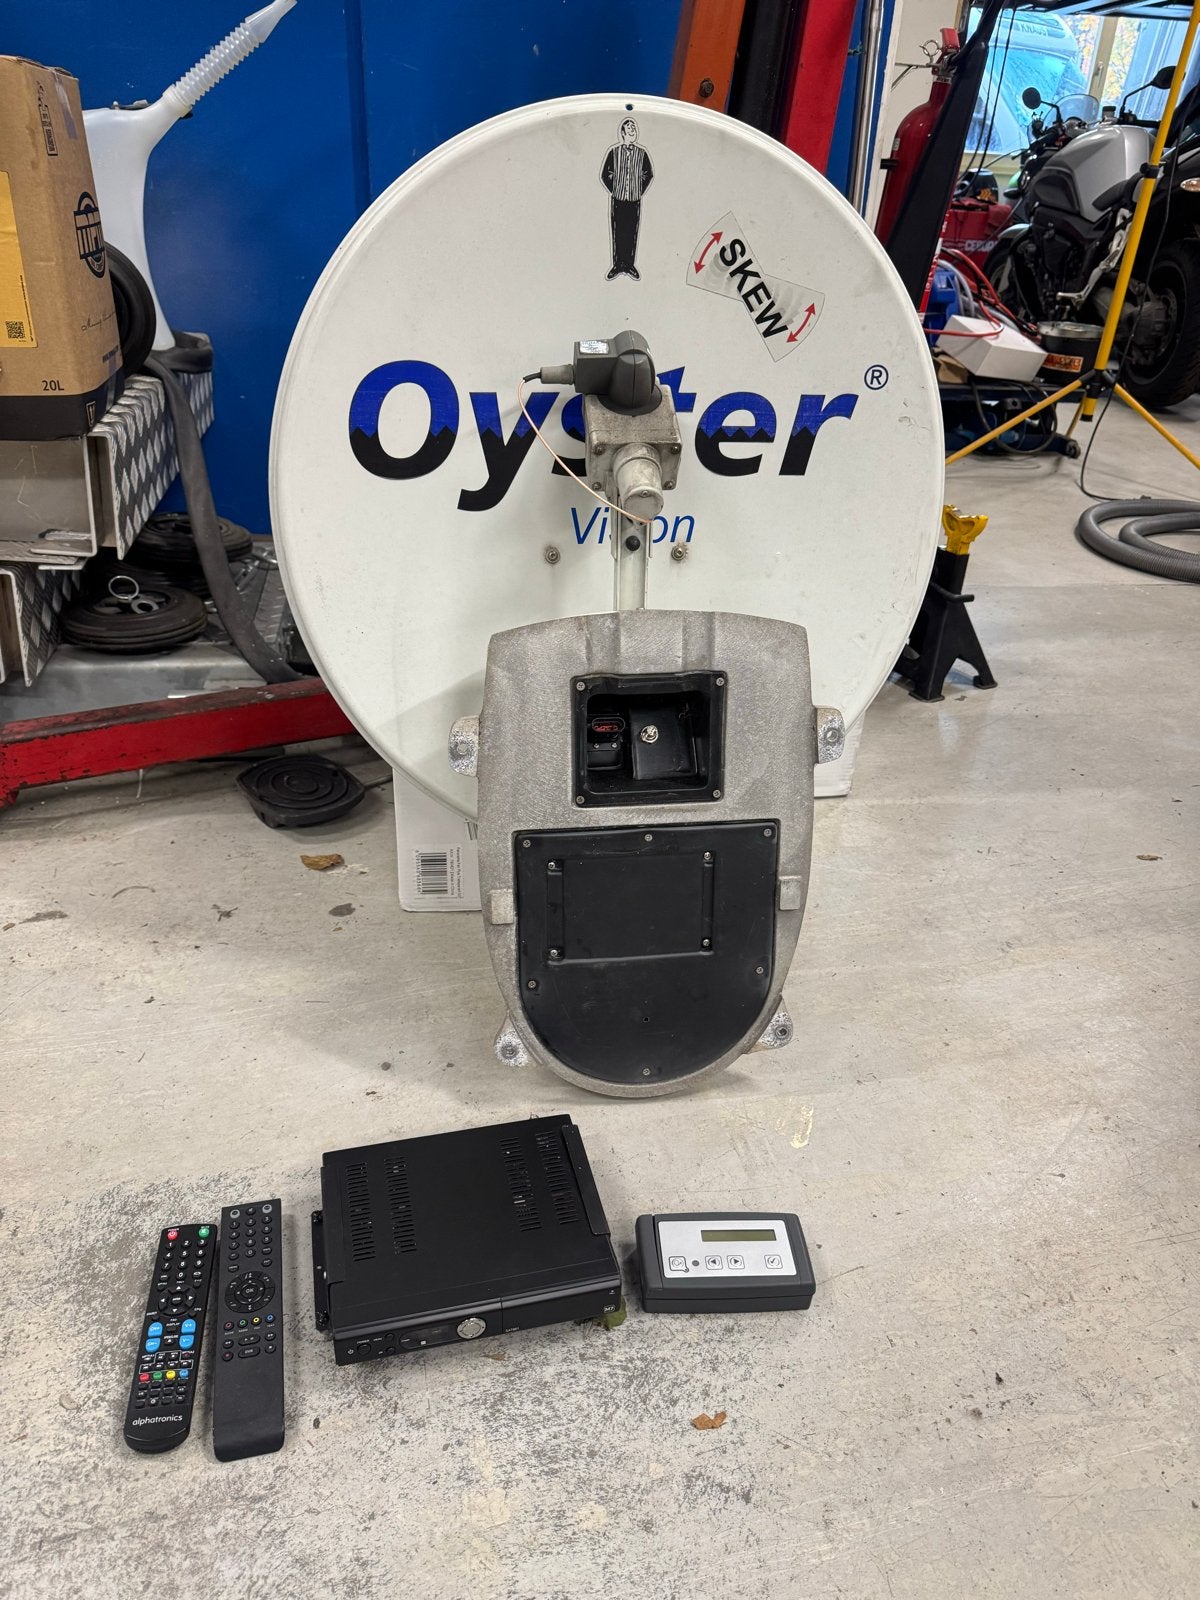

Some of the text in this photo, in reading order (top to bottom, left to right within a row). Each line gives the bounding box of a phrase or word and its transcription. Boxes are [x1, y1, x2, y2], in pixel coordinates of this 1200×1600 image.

[718, 238, 788, 340] SKEW
[41, 380, 65, 391] 20L
[570, 506, 696, 545] Vion
[132, 1414, 183, 1427] alphatronics
